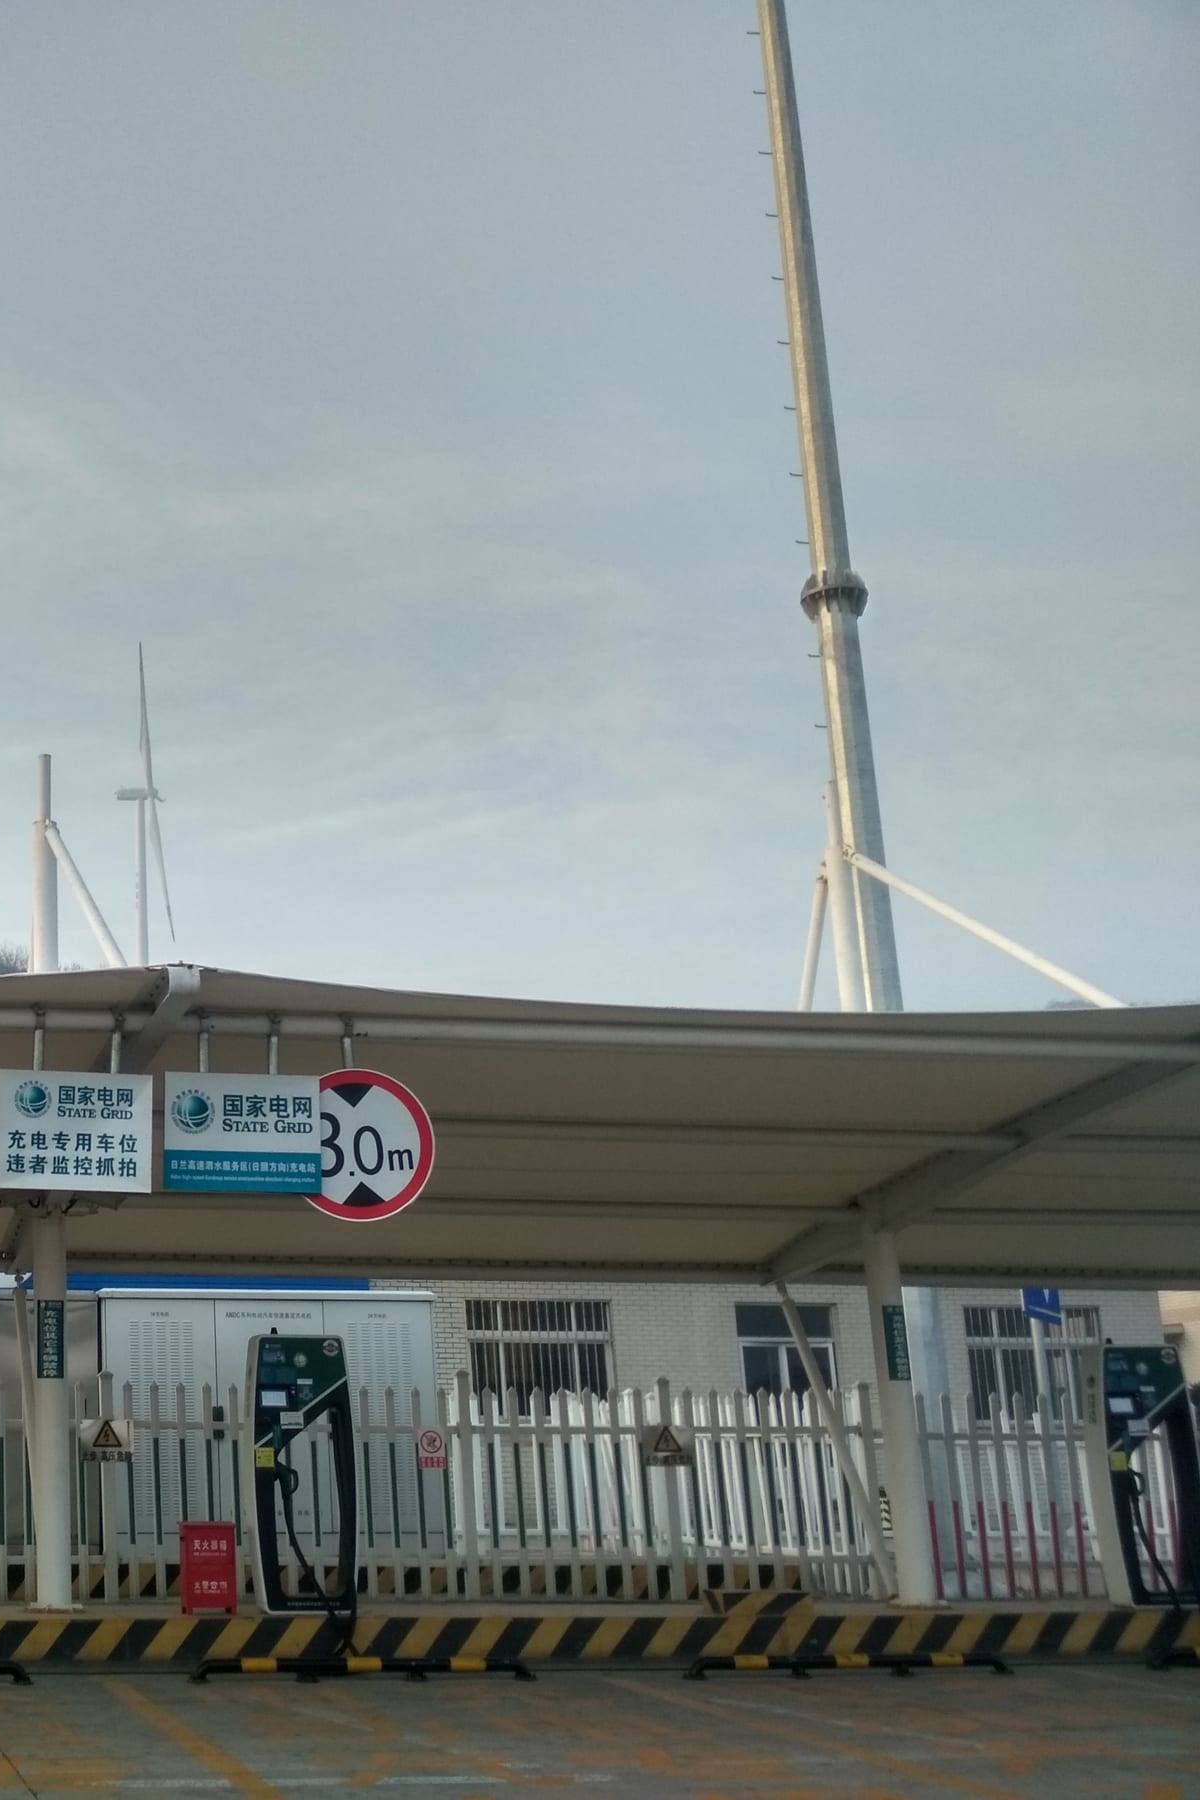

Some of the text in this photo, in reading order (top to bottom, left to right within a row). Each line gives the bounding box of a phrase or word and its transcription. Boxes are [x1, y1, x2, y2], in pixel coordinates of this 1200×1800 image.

[58, 1085, 133, 1107] 国家电网
[223, 1094, 312, 1118] 国家电网
[57, 1105, 133, 1120] STATE GRID
[222, 1118, 313, 1134] STATE GRID
[8, 1130, 137, 1153] 充电专用车位
[6, 1153, 137, 1177] 违者监控抓拍
